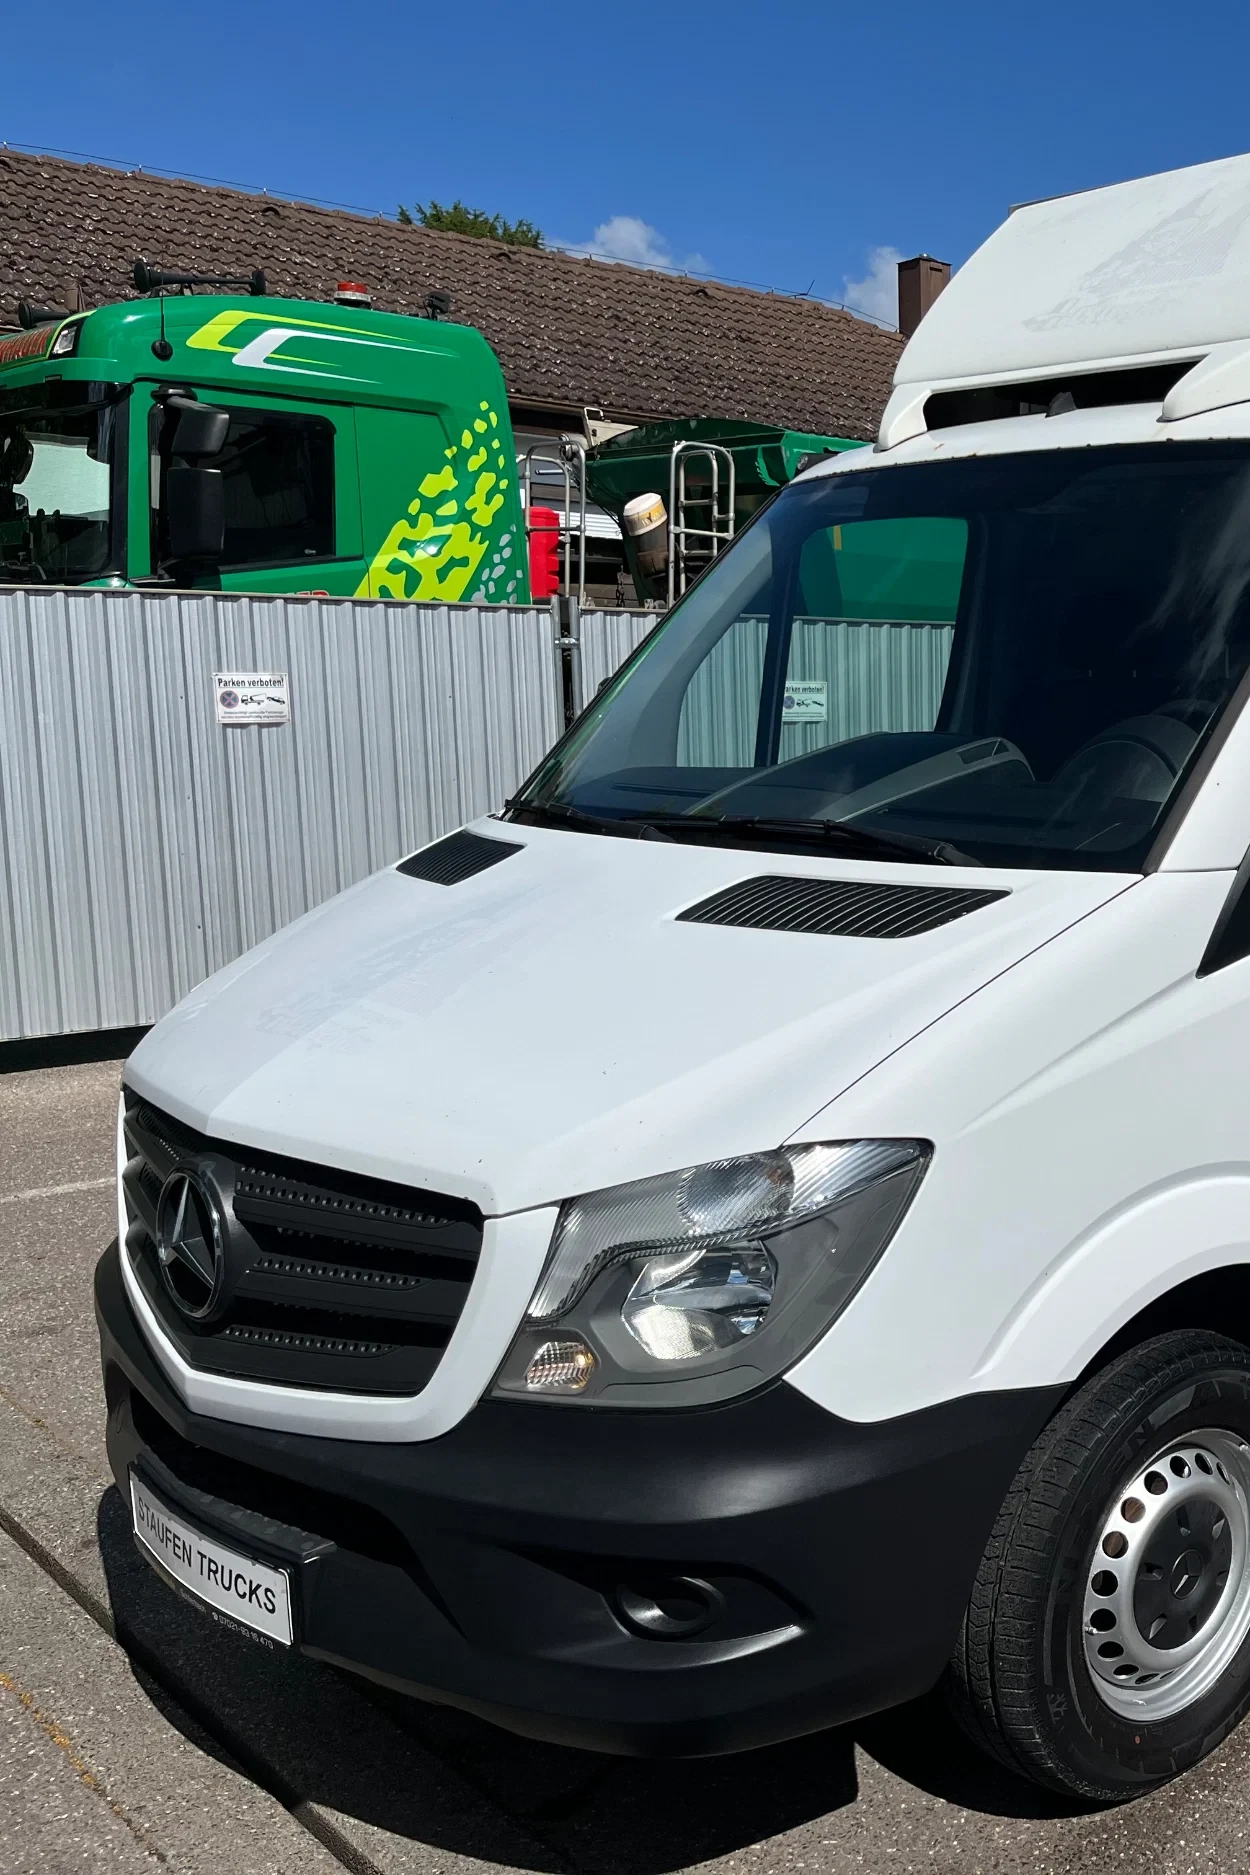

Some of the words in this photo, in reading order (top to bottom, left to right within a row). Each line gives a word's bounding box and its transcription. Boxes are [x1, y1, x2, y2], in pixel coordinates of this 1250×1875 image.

[218, 678, 246, 687] Parken
[247, 678, 284, 687] verboten!
[138, 1496, 193, 1568] STAUFEN
[197, 1550, 277, 1615] TRUCKS
